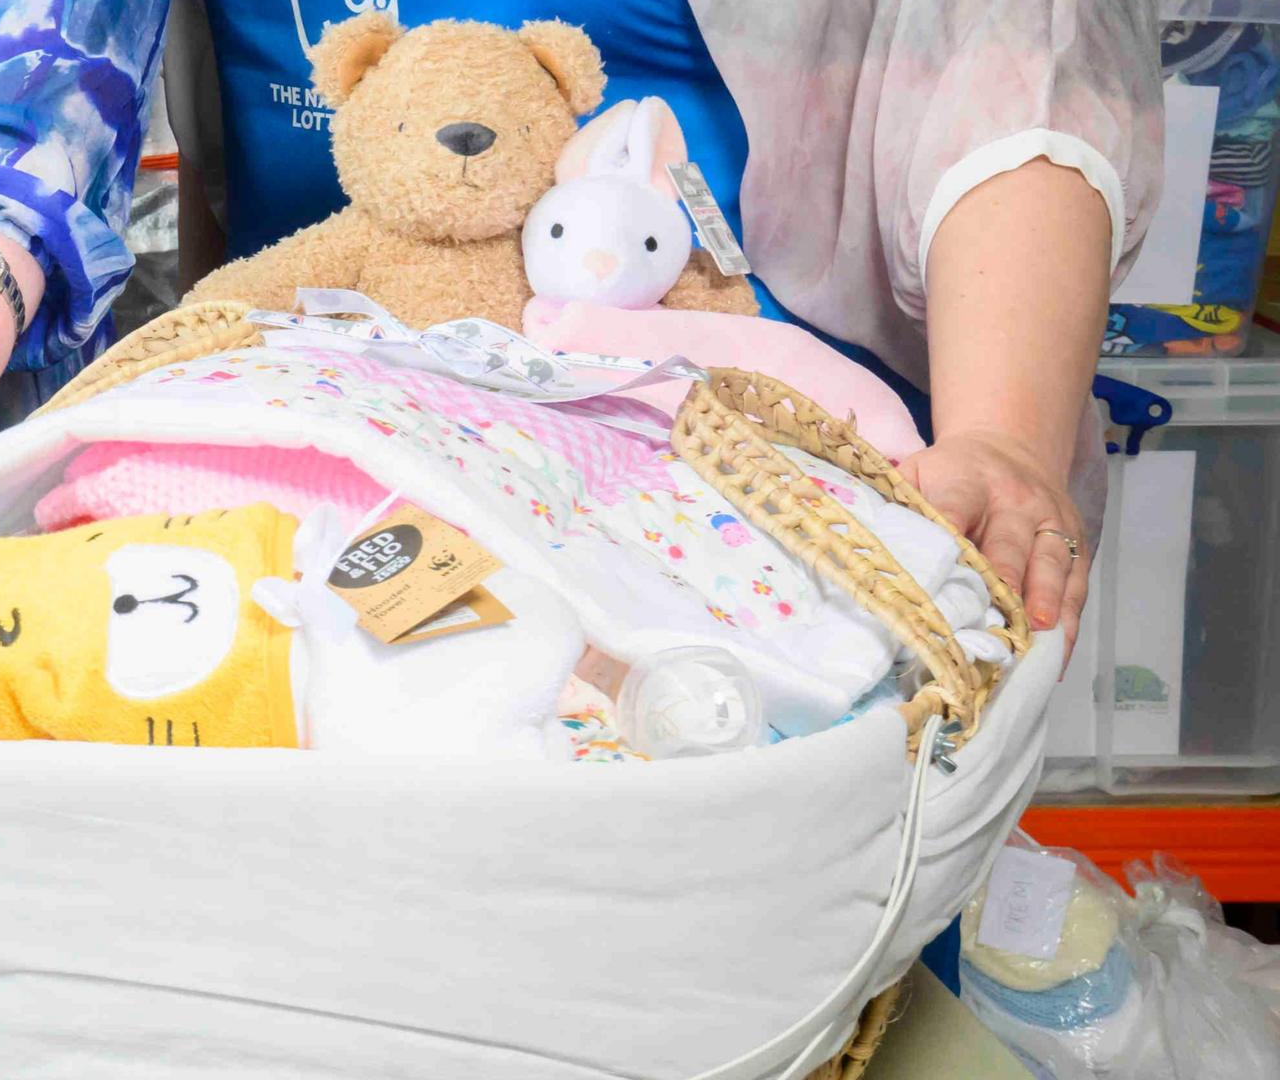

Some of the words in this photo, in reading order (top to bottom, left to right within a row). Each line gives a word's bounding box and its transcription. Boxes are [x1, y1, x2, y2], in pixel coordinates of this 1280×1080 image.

[269, 82, 302, 106] THE
[292, 108, 334, 133] LOTT
[335, 532, 396, 573] FRED
[361, 542, 403, 572] FLO
[366, 583, 411, 616] Hooded
[374, 597, 406, 620] Towel
